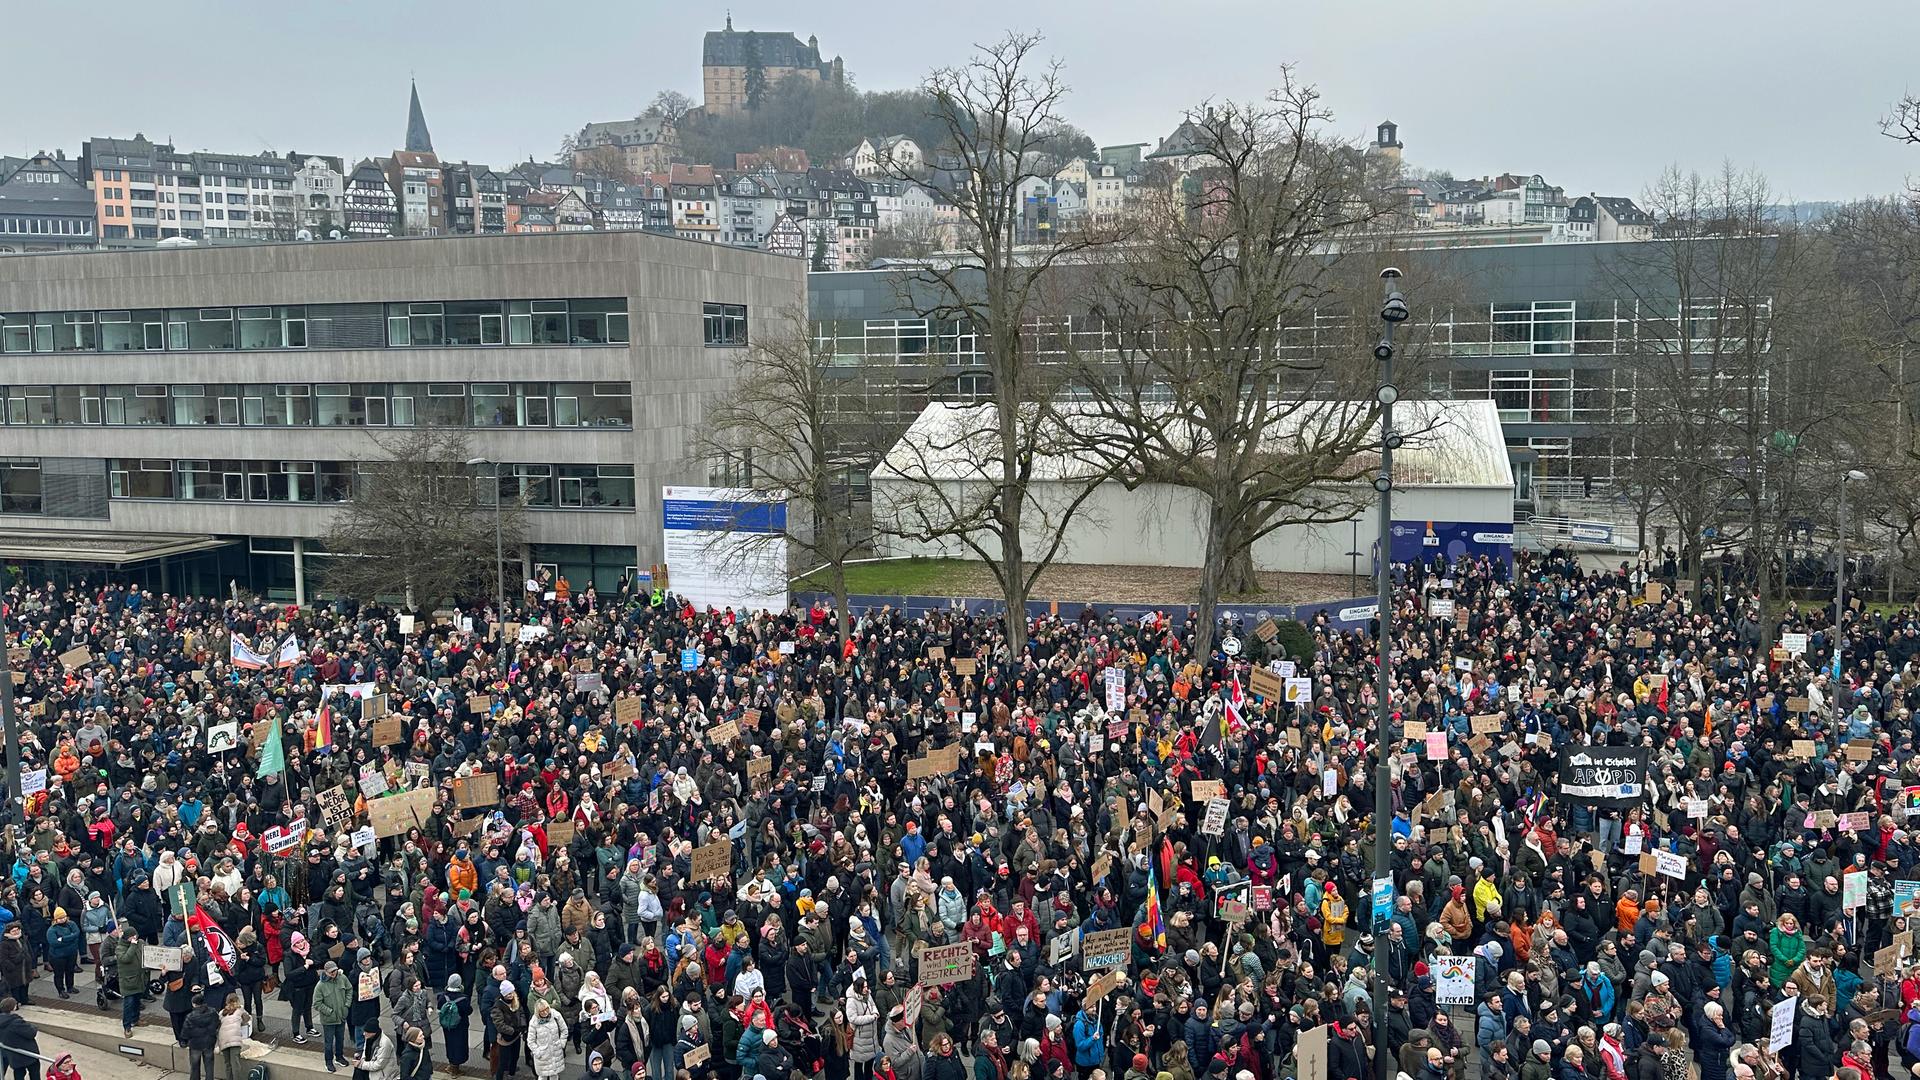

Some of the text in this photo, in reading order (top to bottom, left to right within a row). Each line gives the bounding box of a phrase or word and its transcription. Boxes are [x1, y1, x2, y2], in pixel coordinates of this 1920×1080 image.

[1349, 607, 1370, 615] EINGANG
[322, 788, 338, 800] NIE
[319, 793, 347, 810] WIEDER
[329, 803, 344, 815] IST
[289, 820, 306, 833] STATT
[265, 829, 280, 841] HERZ
[695, 849, 715, 862] DAS
[924, 945, 969, 962] RECHTS
[926, 960, 942, 969] wird
[1448, 957, 1468, 967] NÖ!
